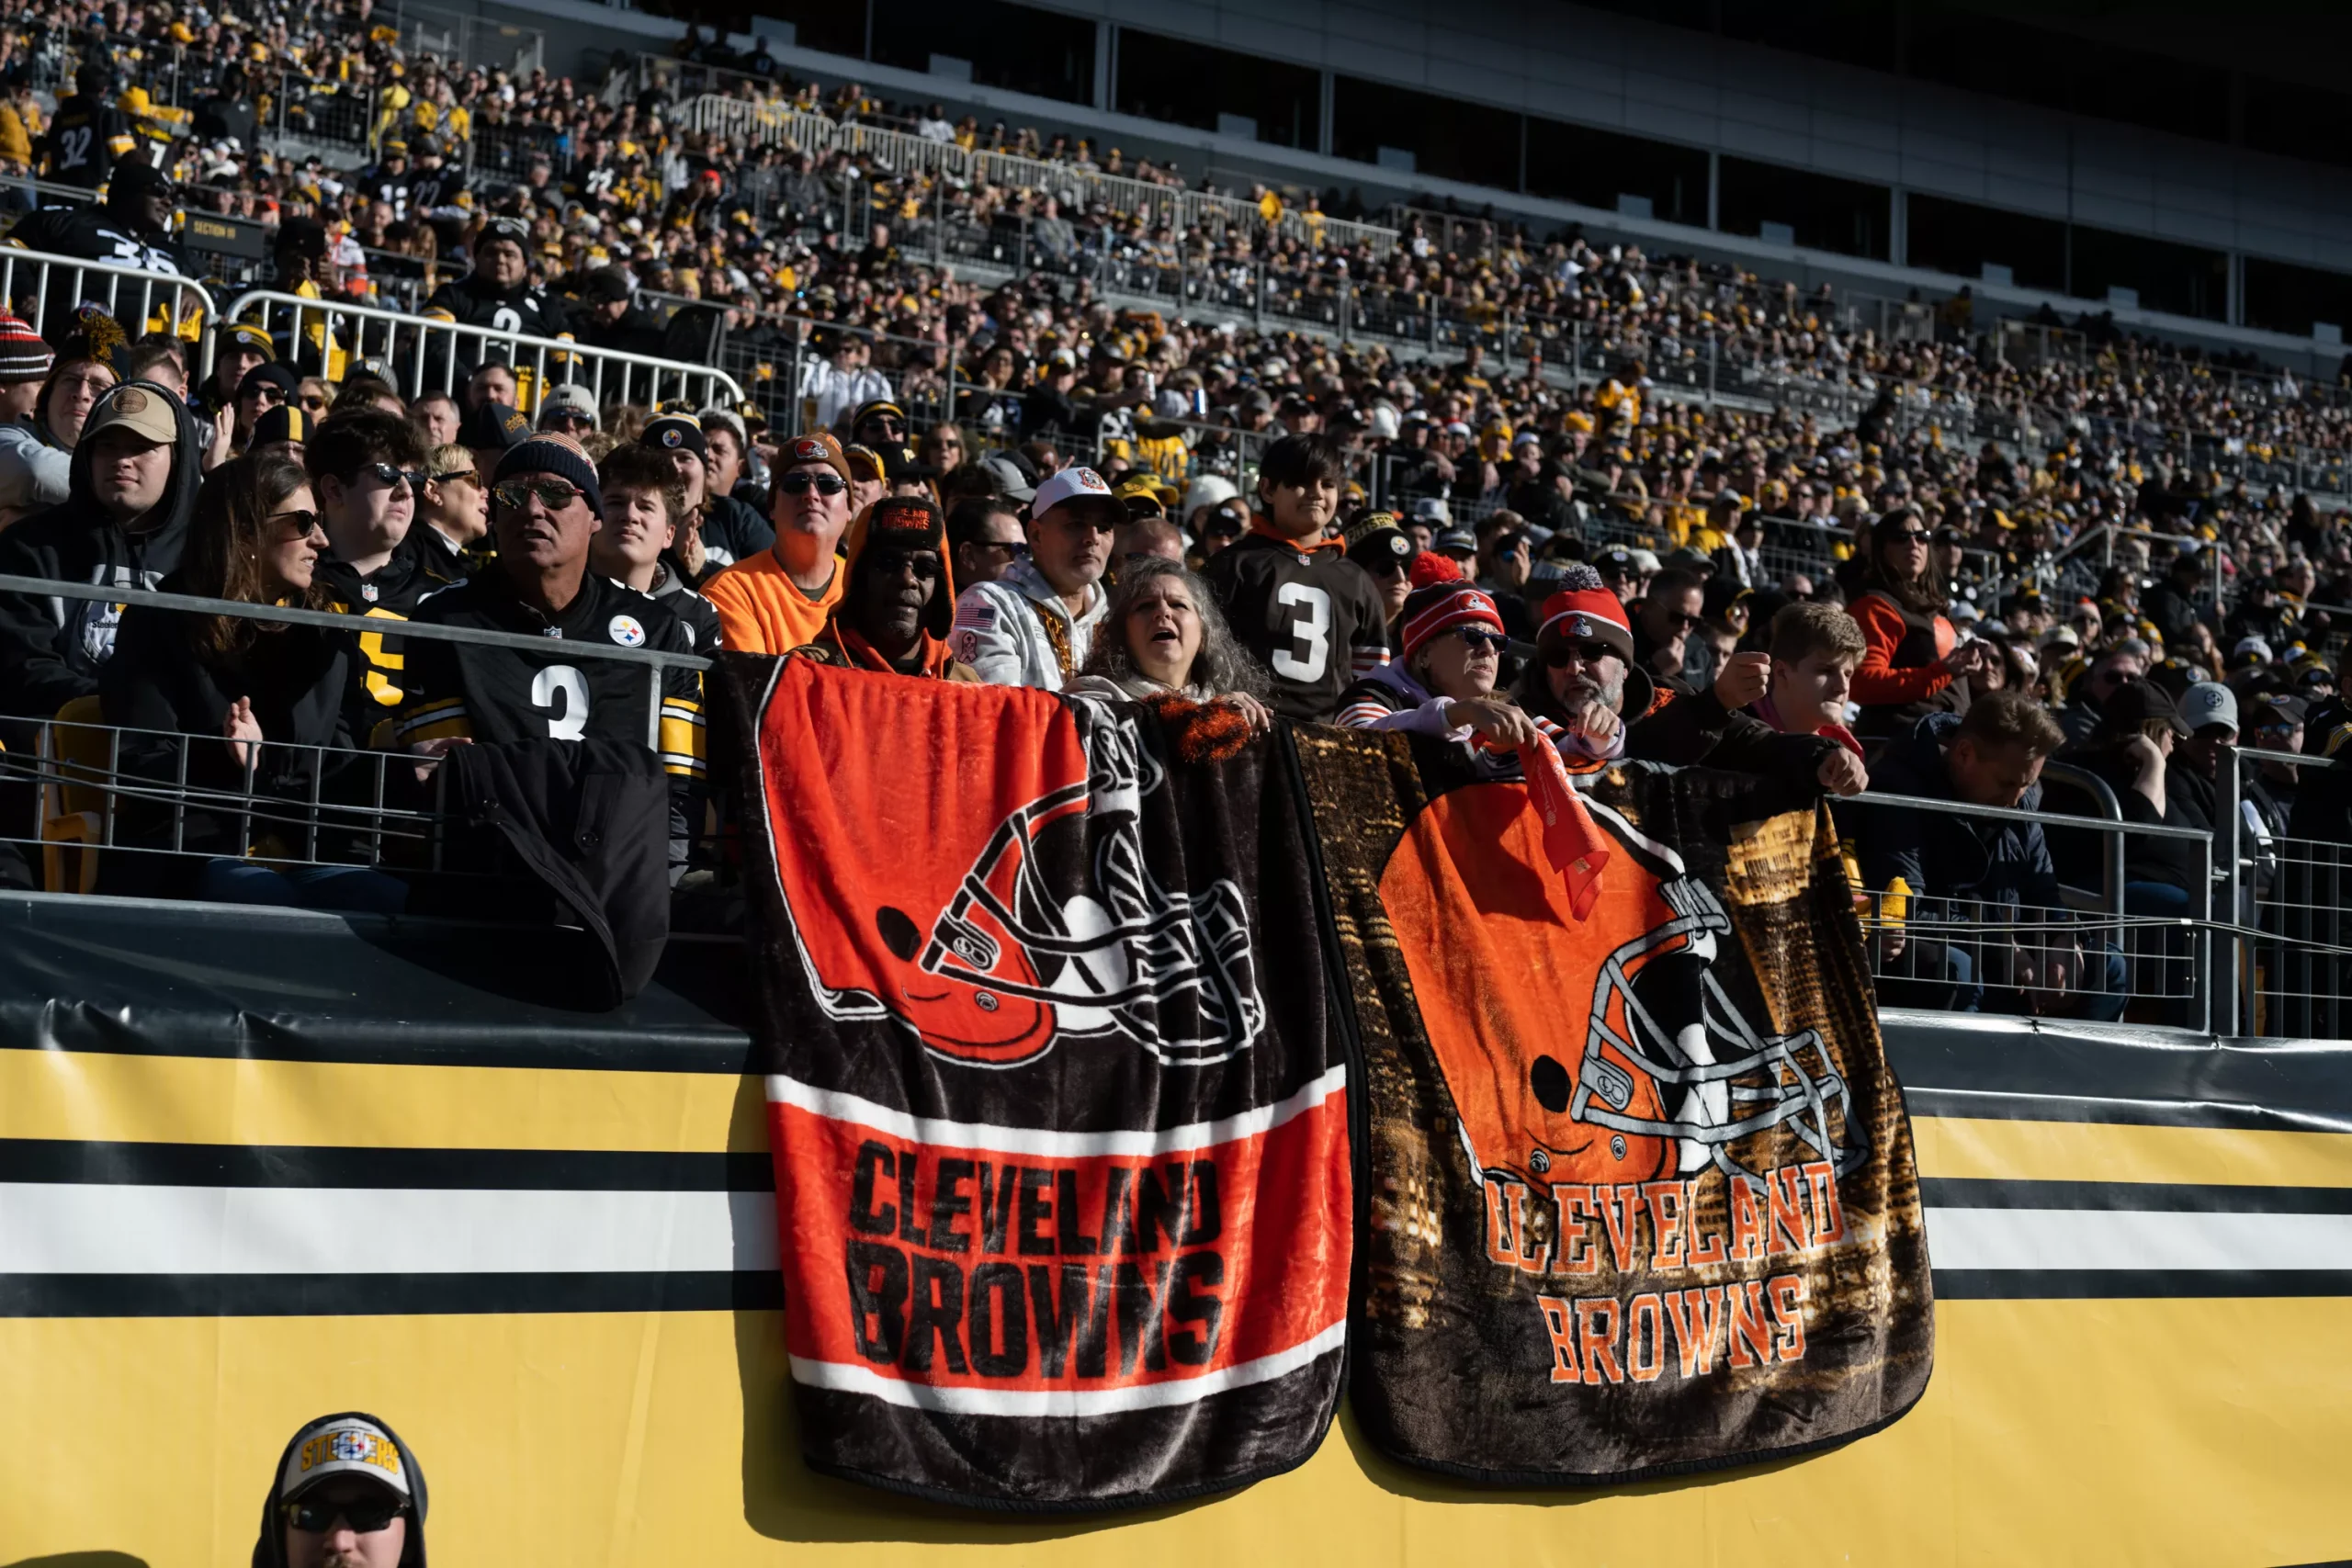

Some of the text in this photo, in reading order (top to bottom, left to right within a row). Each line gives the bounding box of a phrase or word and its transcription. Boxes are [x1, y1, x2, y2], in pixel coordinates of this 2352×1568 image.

[60, 125, 92, 170] 32
[193, 220, 226, 237] SECTION
[92, 619, 119, 629] Steeler
[1272, 581, 1331, 683] 3
[845, 1238, 1224, 1379] BROWNS
[1536, 1273, 1810, 1385] BROWNS
[300, 1431, 400, 1475] STEERS
